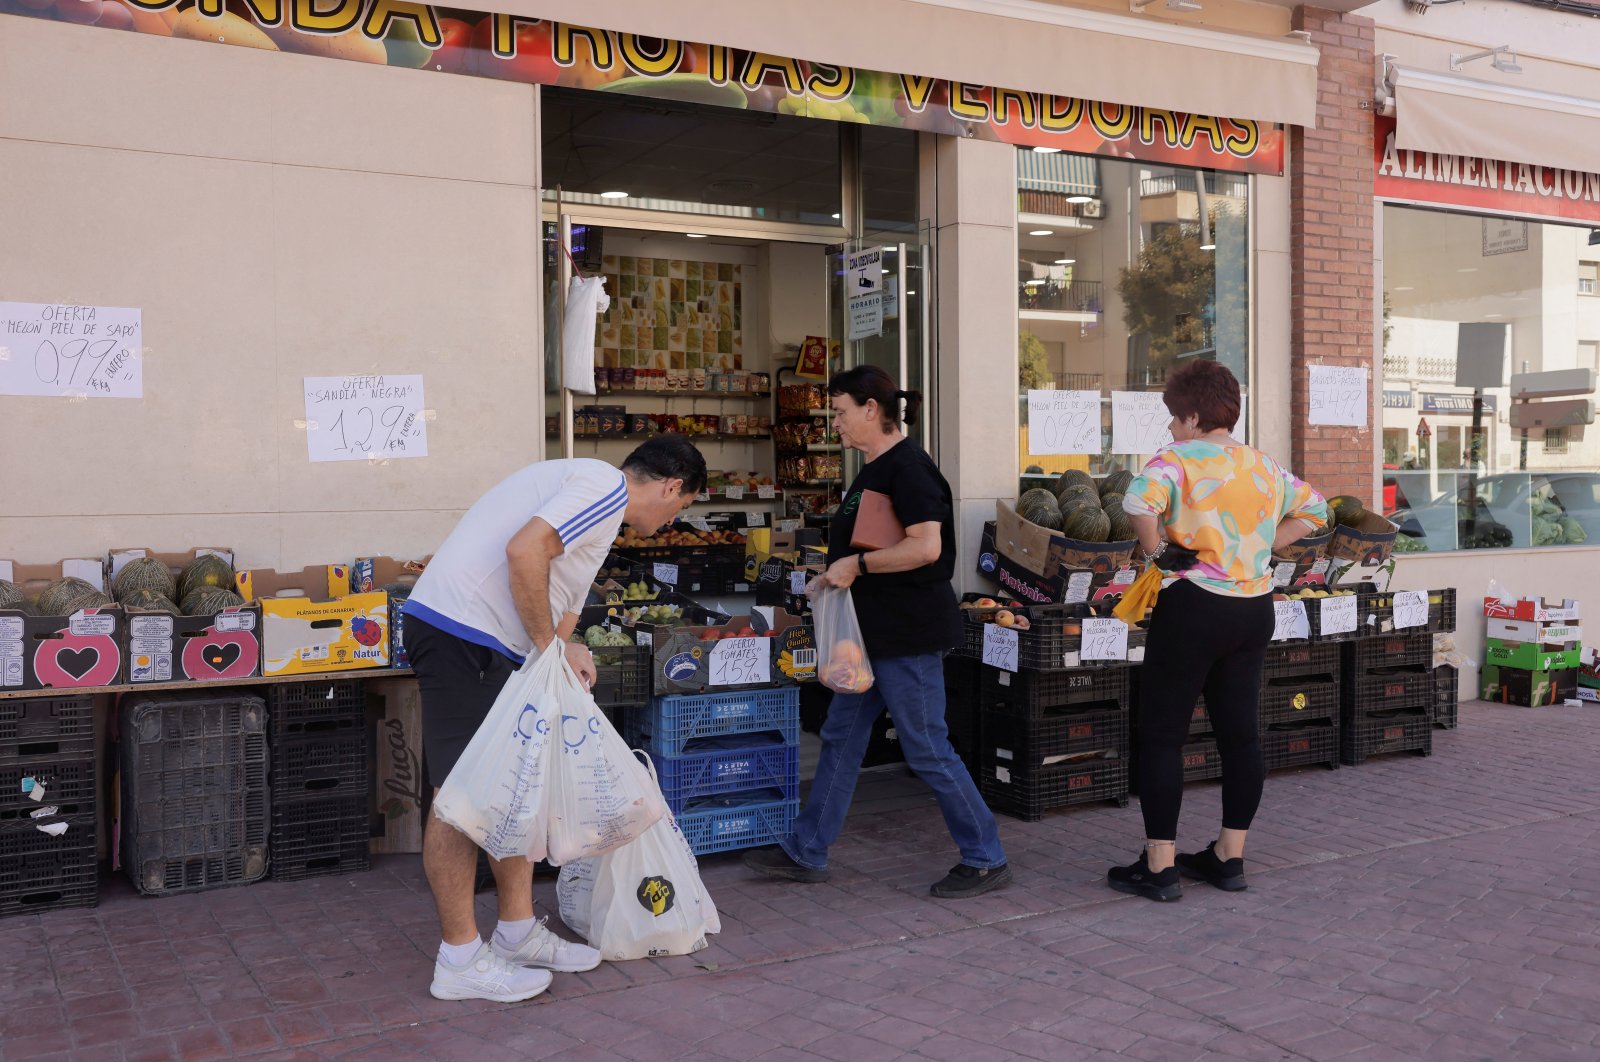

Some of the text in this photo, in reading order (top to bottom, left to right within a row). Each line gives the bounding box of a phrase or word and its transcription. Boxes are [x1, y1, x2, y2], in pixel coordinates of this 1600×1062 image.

[850, 297, 880, 310] HORARIO
[41, 305, 96, 321] OFERTA
[50, 322, 76, 336] PIEL
[83, 323, 97, 335] DE
[342, 375, 385, 390] OFERTA
[1052, 391, 1081, 400] OFERTA
[330, 405, 405, 454] 1,29
[789, 628, 806, 638] High
[726, 638, 756, 650] OFERTA
[787, 636, 811, 649] Quality
[353, 649, 382, 659] Natur
[1077, 675, 1092, 686] VALE
[733, 703, 749, 711] VALE
[383, 718, 421, 809] Lucas
[733, 761, 749, 769] VALE
[733, 818, 749, 826] VALE
